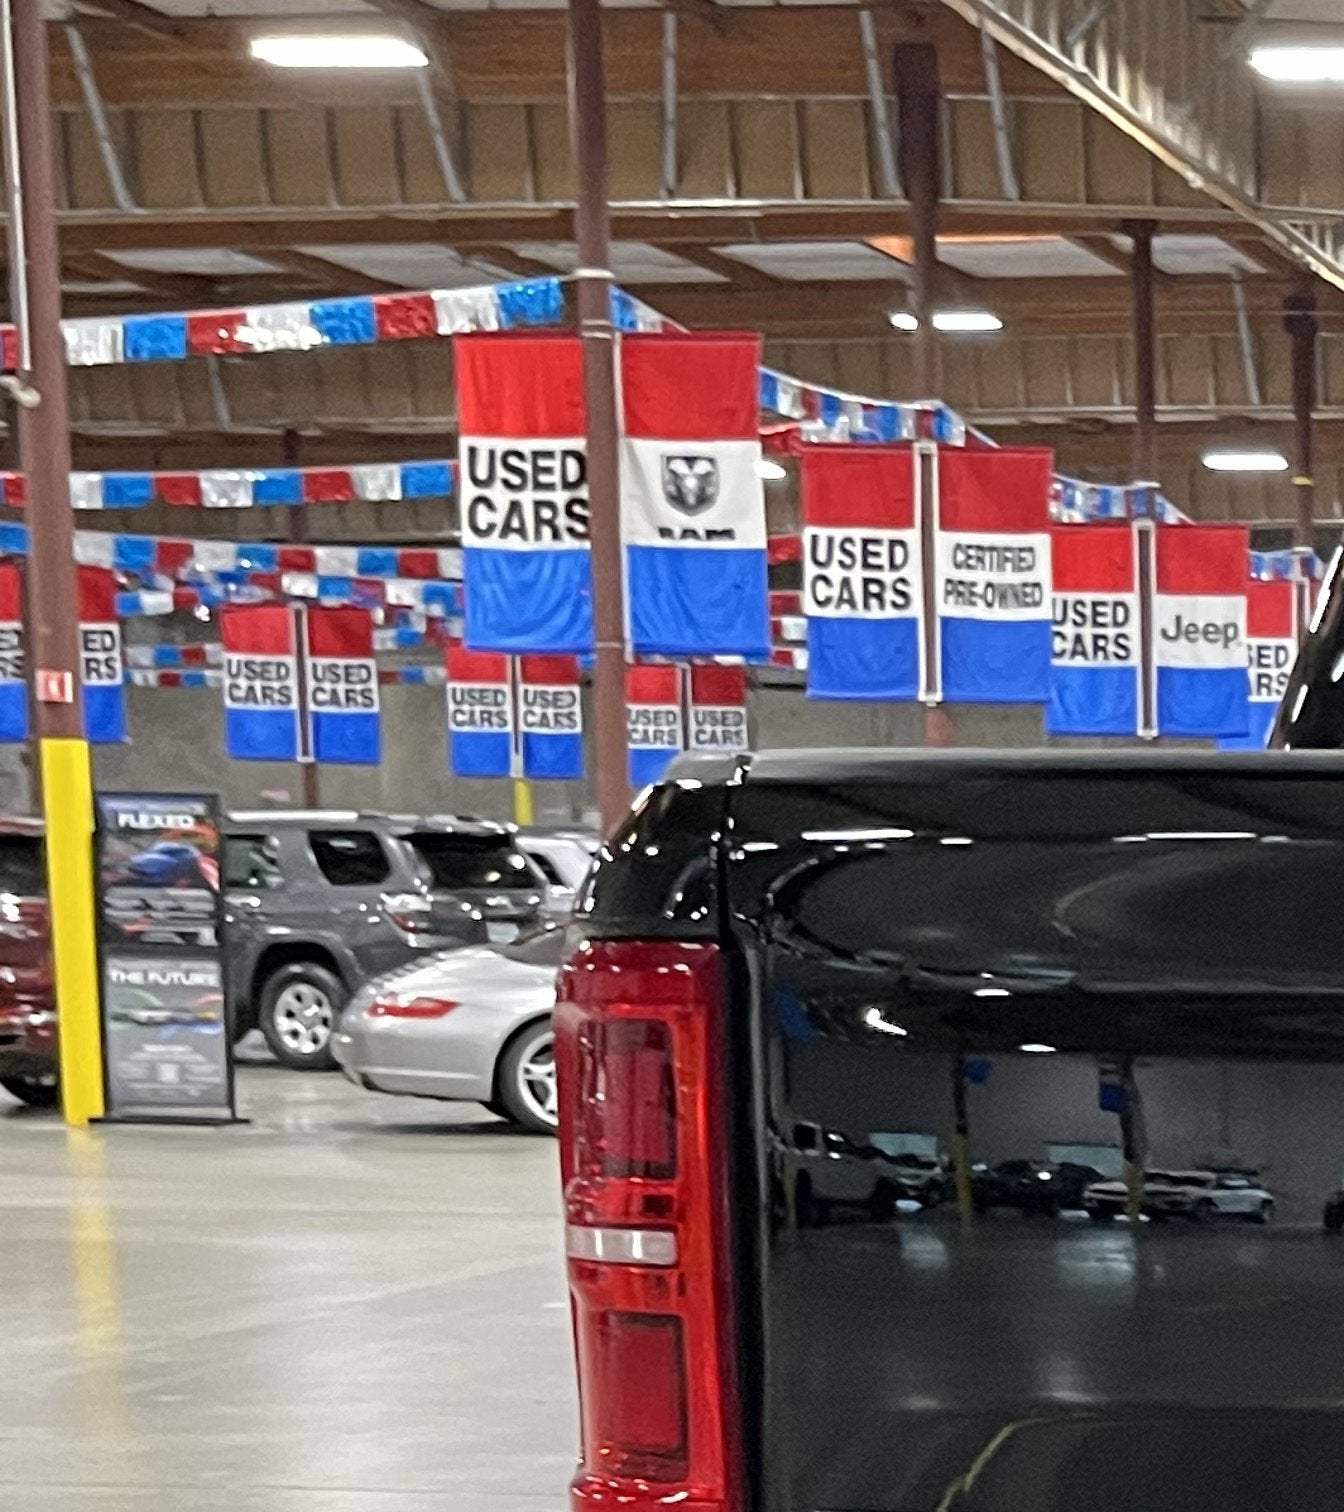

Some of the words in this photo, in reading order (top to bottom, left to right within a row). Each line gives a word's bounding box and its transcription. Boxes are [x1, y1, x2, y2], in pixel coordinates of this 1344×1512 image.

[467, 446, 587, 492] USED
[468, 496, 591, 541] CARS
[658, 526, 736, 540] RAM
[810, 534, 909, 572] USED
[953, 543, 1036, 573] CERTIFIED
[811, 573, 912, 611] CARS
[944, 578, 1043, 609] PRE-OWNED
[1052, 598, 1130, 628] USED
[83, 630, 116, 652] ED
[1160, 615, 1239, 648] Jeep
[1052, 631, 1131, 661] CARS
[84, 657, 117, 680] RS
[227, 658, 290, 682] USED
[312, 662, 372, 685] USED
[229, 683, 292, 705] CARS
[312, 686, 374, 708] CARS
[451, 686, 507, 706] USED
[523, 688, 577, 708] USED
[452, 708, 508, 728] CARS
[523, 709, 578, 729] CARS
[628, 708, 677, 726] USED
[694, 710, 743, 727] USED
[629, 728, 678, 746] CARS
[694, 728, 744, 746] CARS
